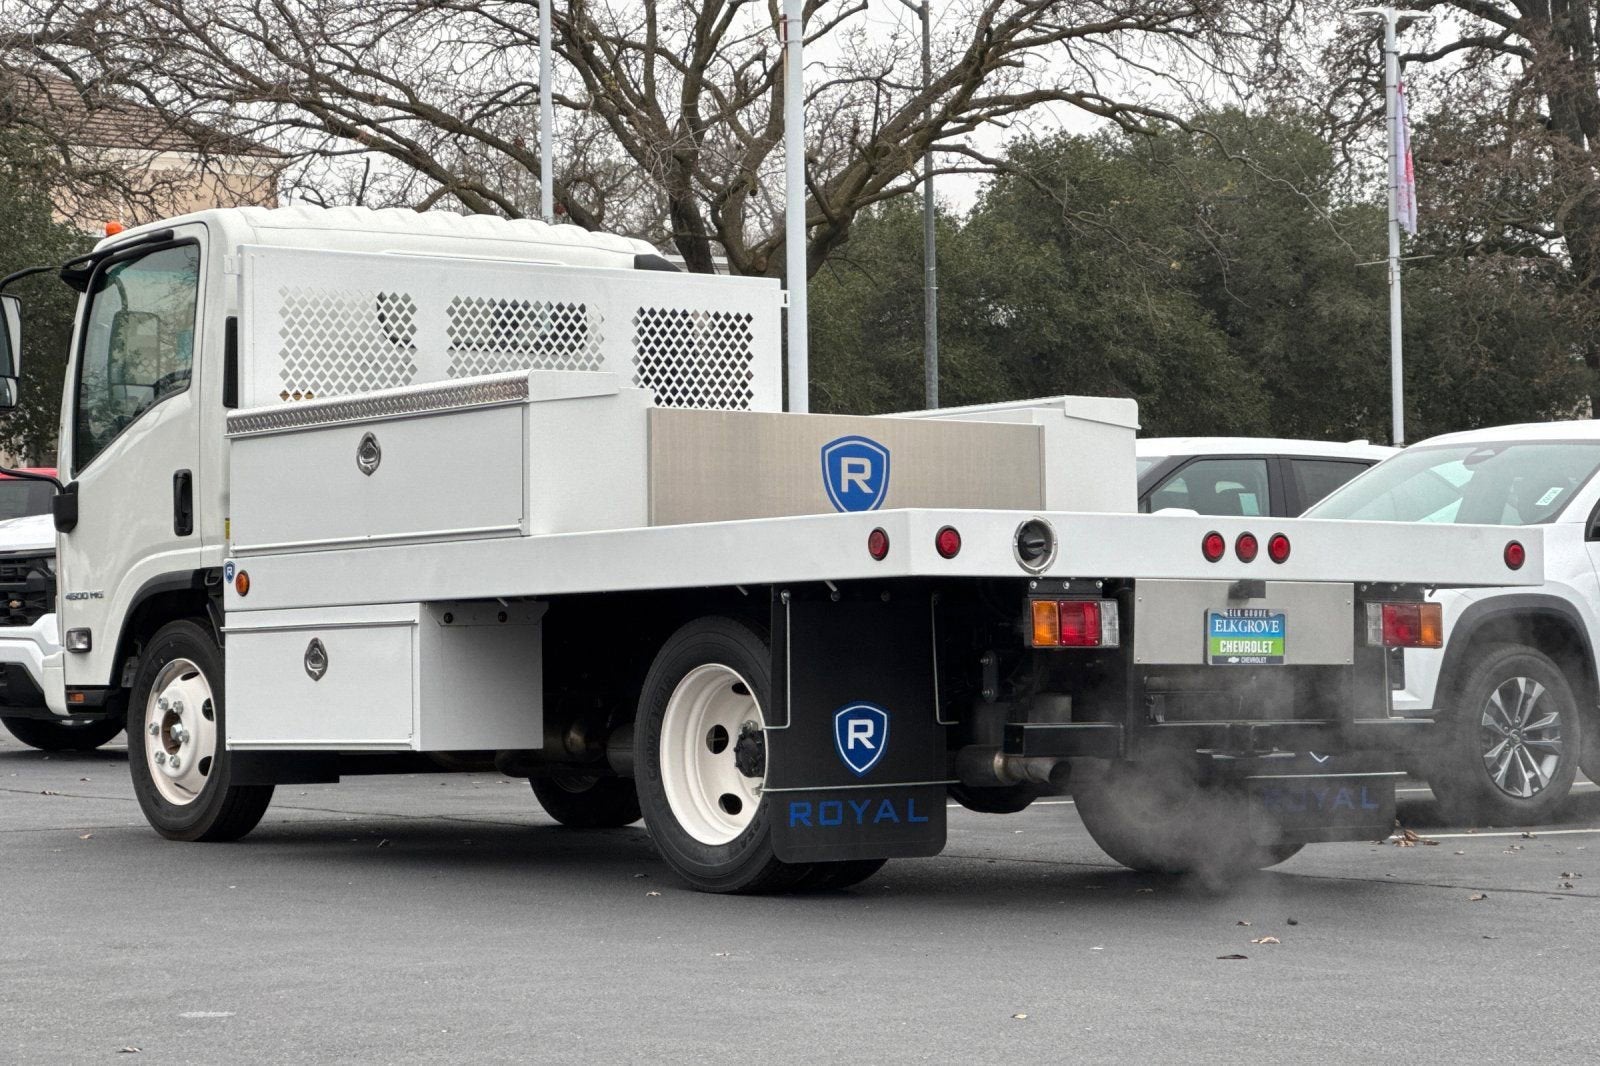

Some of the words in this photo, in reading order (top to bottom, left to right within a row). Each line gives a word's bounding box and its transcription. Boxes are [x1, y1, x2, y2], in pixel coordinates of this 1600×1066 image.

[841, 456, 874, 494] R
[1229, 609, 1241, 617] ELK
[1244, 609, 1267, 617] GROVE
[1220, 640, 1274, 654] CHEVROLET
[1240, 656, 1267, 664] CHEVROLET
[847, 718, 876, 750] R
[788, 798, 929, 828] ROYAL
